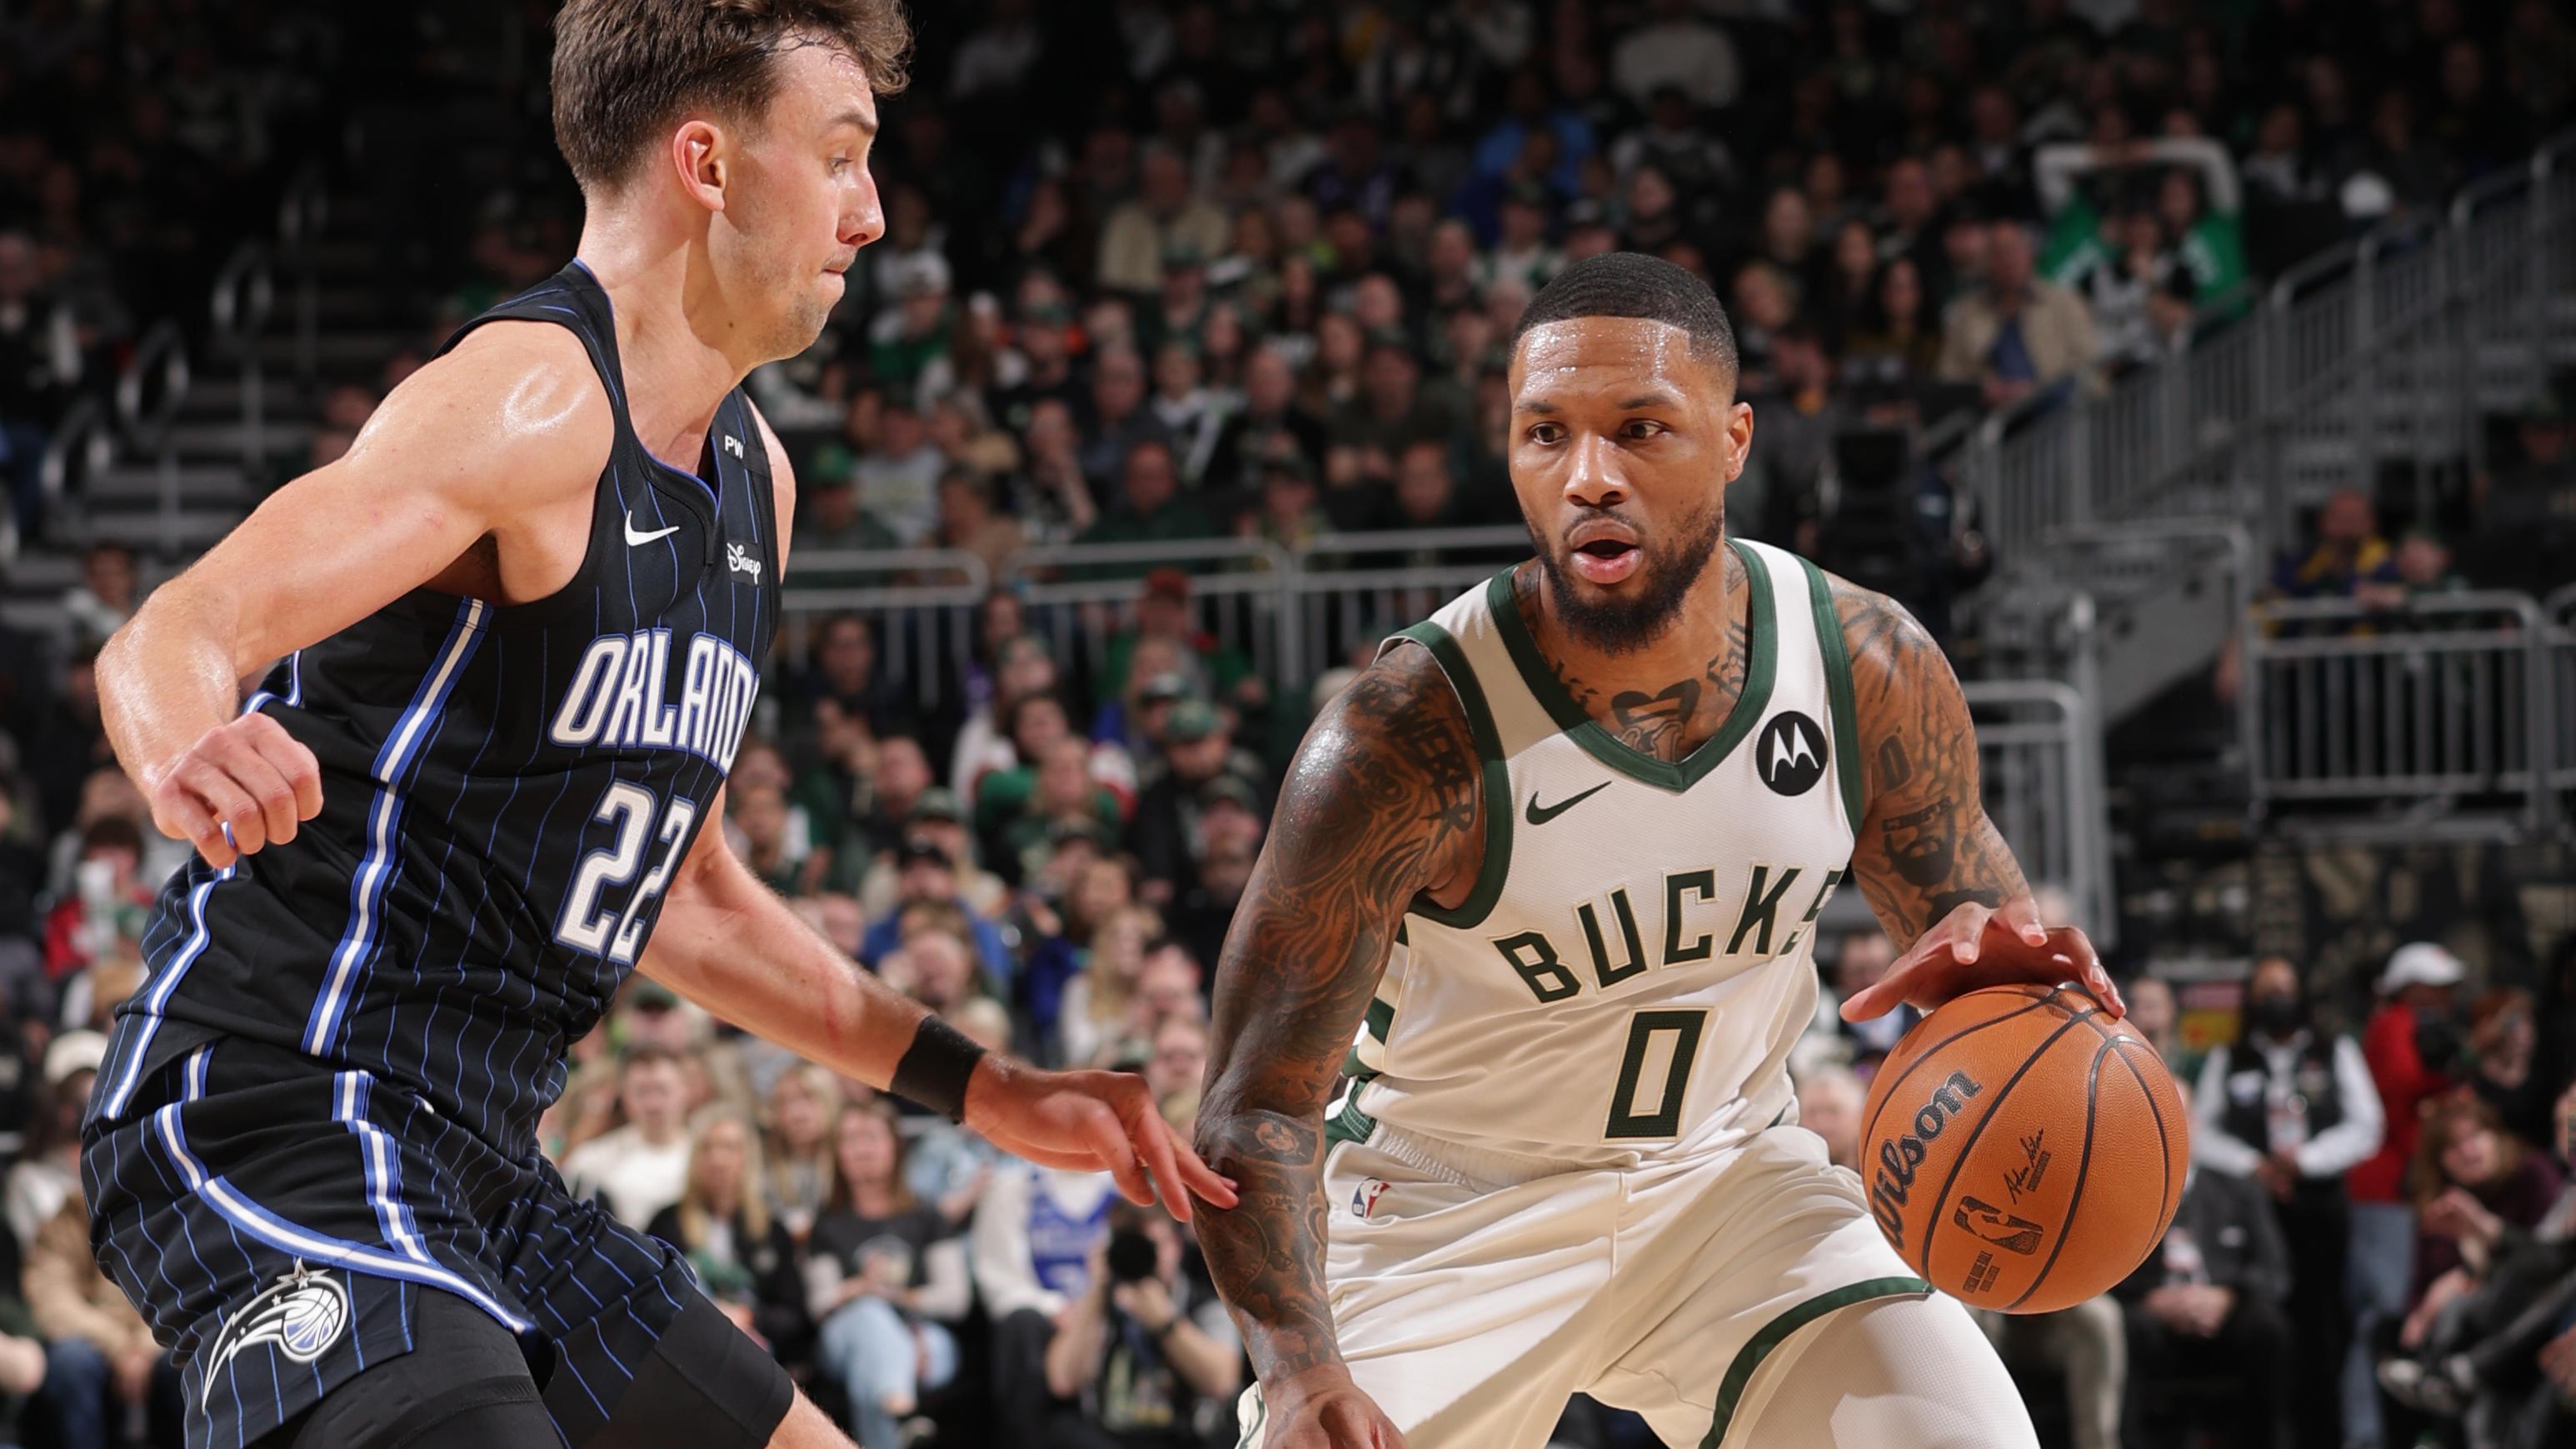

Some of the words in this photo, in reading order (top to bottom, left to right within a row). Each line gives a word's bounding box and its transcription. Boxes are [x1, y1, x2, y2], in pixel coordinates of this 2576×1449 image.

[724, 435, 744, 459] PW
[726, 542, 761, 585] Disney
[547, 627, 760, 778] ORLAND
[552, 778, 696, 965] 22
[1600, 1006, 1716, 1144] 0
[1872, 1069, 1983, 1250] Wilson
